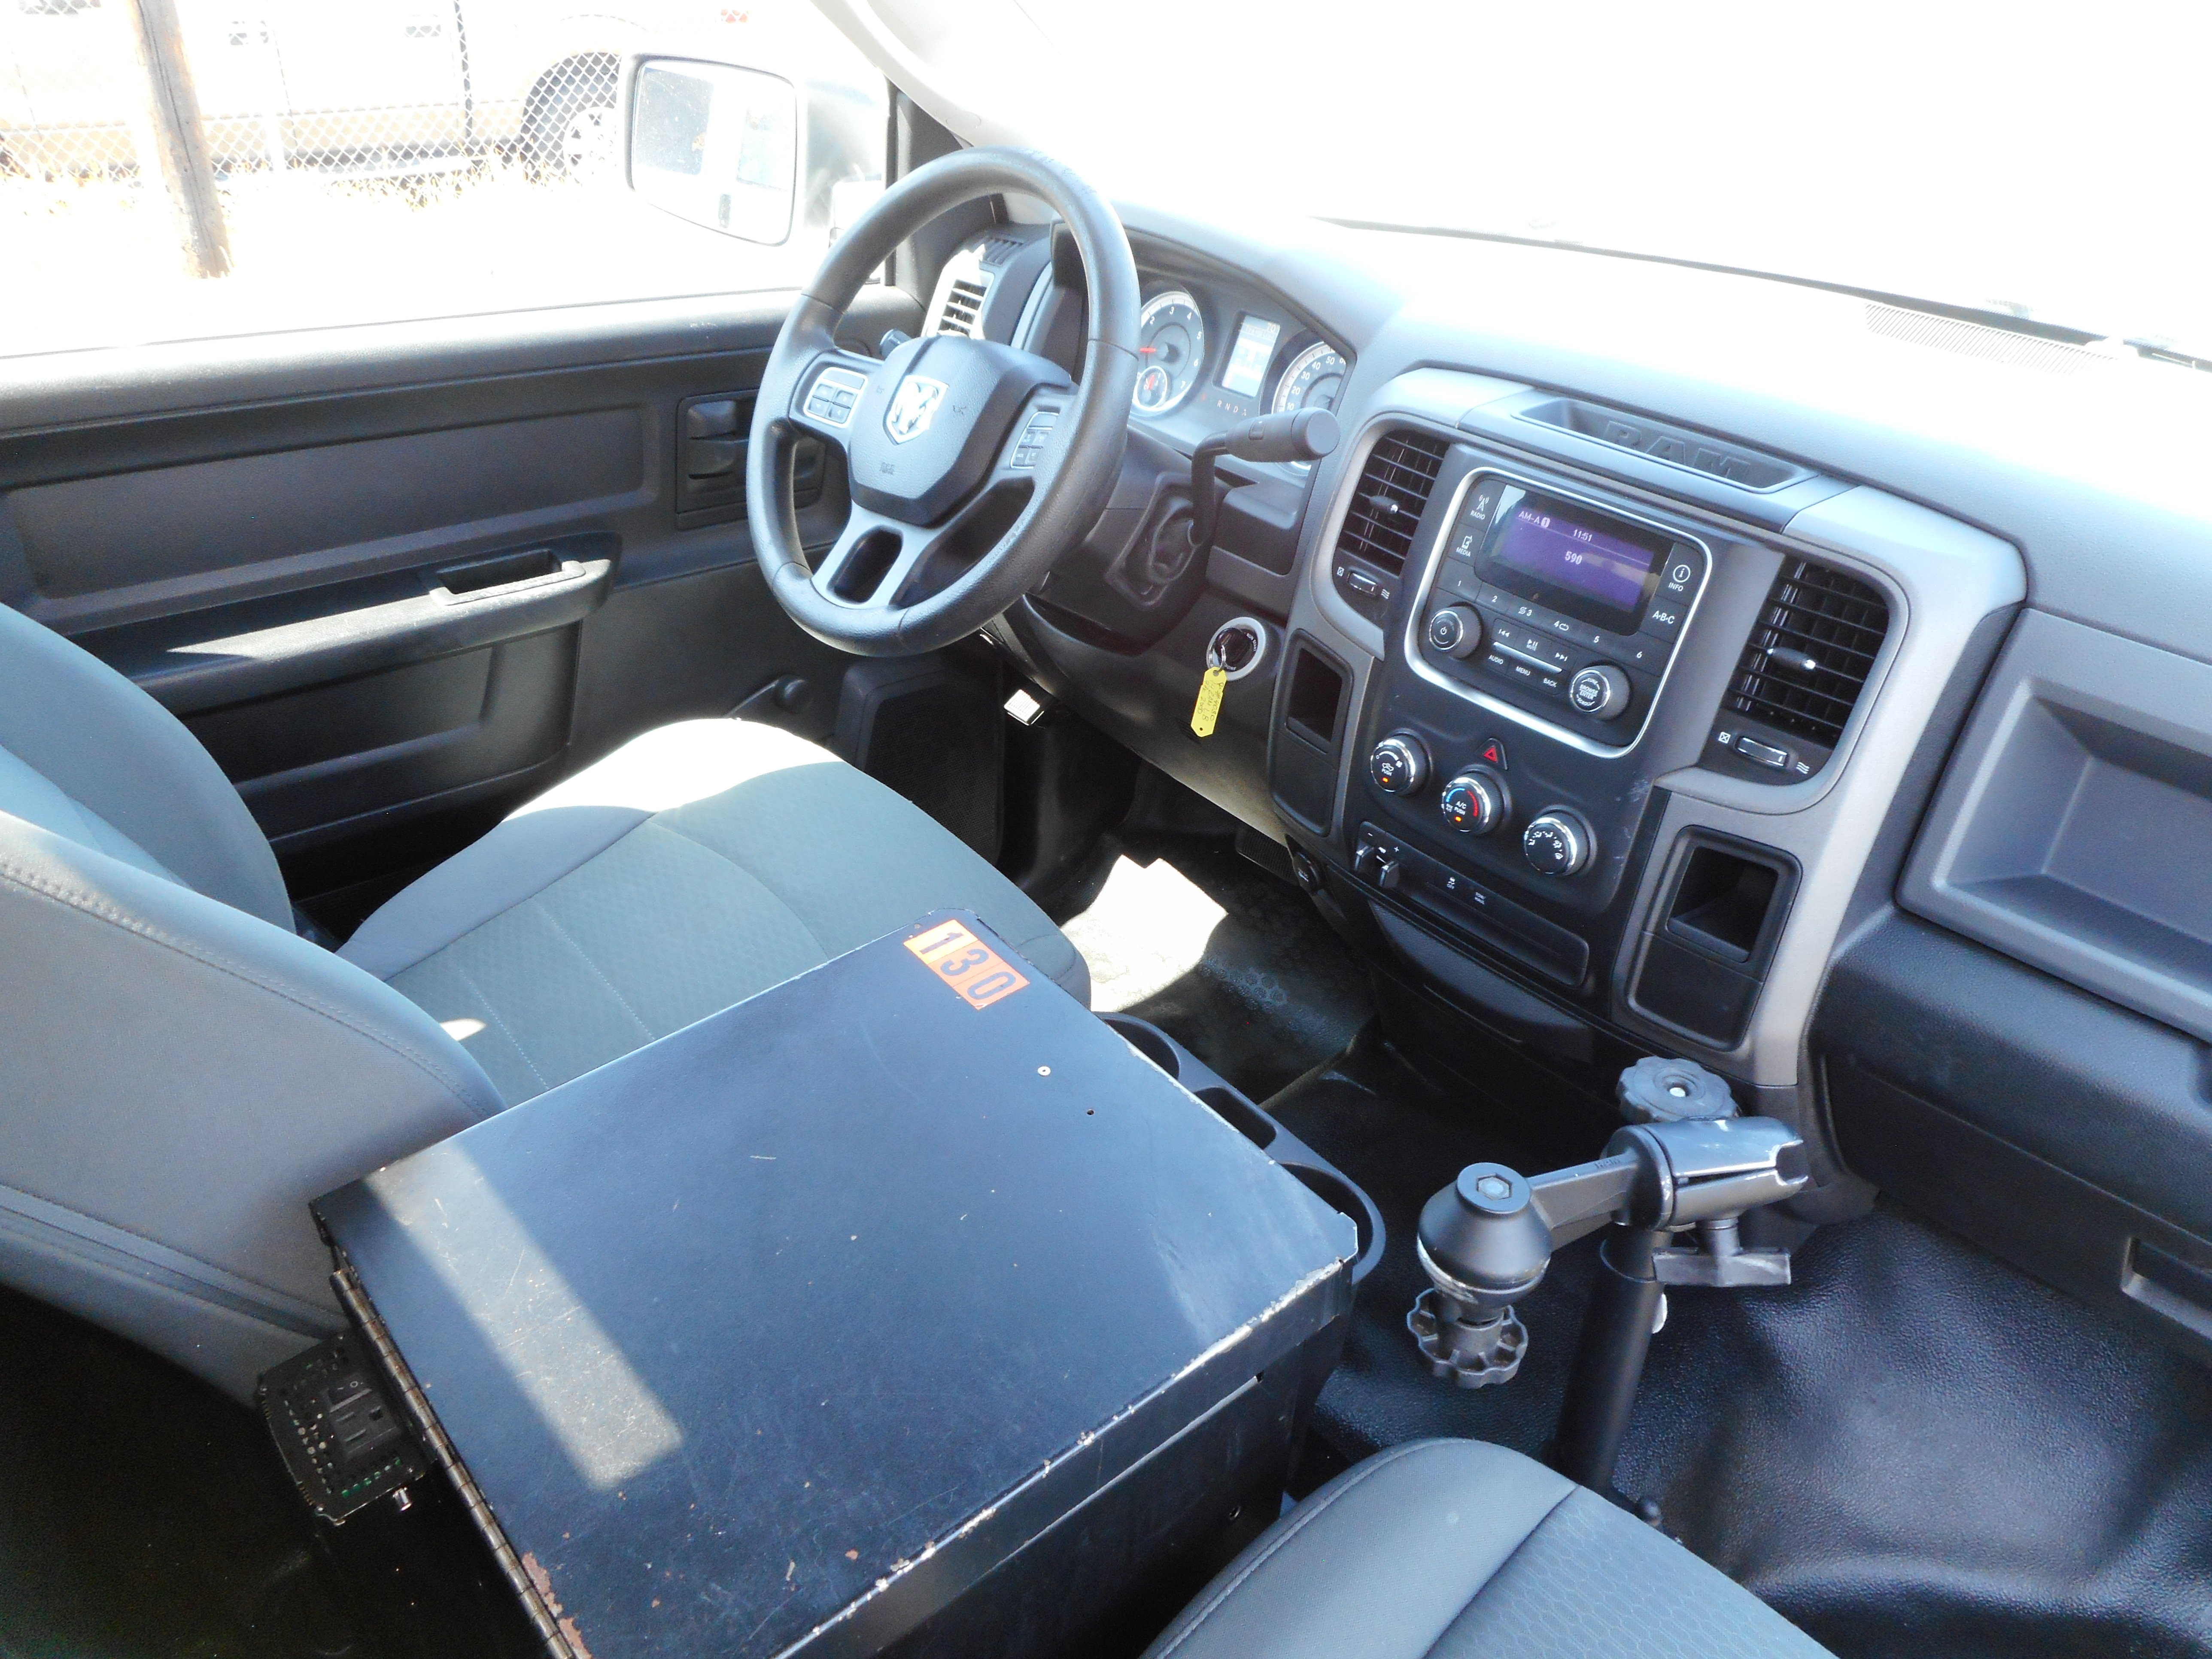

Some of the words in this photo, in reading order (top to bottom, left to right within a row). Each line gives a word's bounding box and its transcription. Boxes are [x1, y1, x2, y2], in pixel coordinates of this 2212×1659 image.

[1169, 307, 1175, 315] 3
[1150, 316, 1155, 325] 2
[1267, 323, 1276, 332] 70
[1197, 331, 1202, 340] 5
[1194, 359, 1198, 367] 6
[1326, 356, 1335, 365] 50
[1312, 362, 1321, 370] 40
[1301, 371, 1310, 380] 30
[1181, 381, 1186, 389] 7
[1291, 386, 1300, 395] 20
[1602, 420, 1750, 480] RAM
[1471, 510, 1486, 520] RADIO
[1518, 511, 1540, 524] AM-A
[1573, 529, 1592, 542] 11:51
[1456, 547, 1471, 557] MEDIA
[1565, 551, 1583, 565] 590
[1668, 582, 1683, 592] INFO
[1488, 655, 1504, 665] AUDIO
[1516, 666, 1531, 676] MENU
[1543, 678, 1558, 687] BACK
[1580, 684, 1598, 696] BROWSE
[1580, 690, 1594, 700] ENTER
[1456, 801, 1466, 809] A/C
[1454, 806, 1465, 815] PUSH
[919, 932, 1016, 1000] 130
